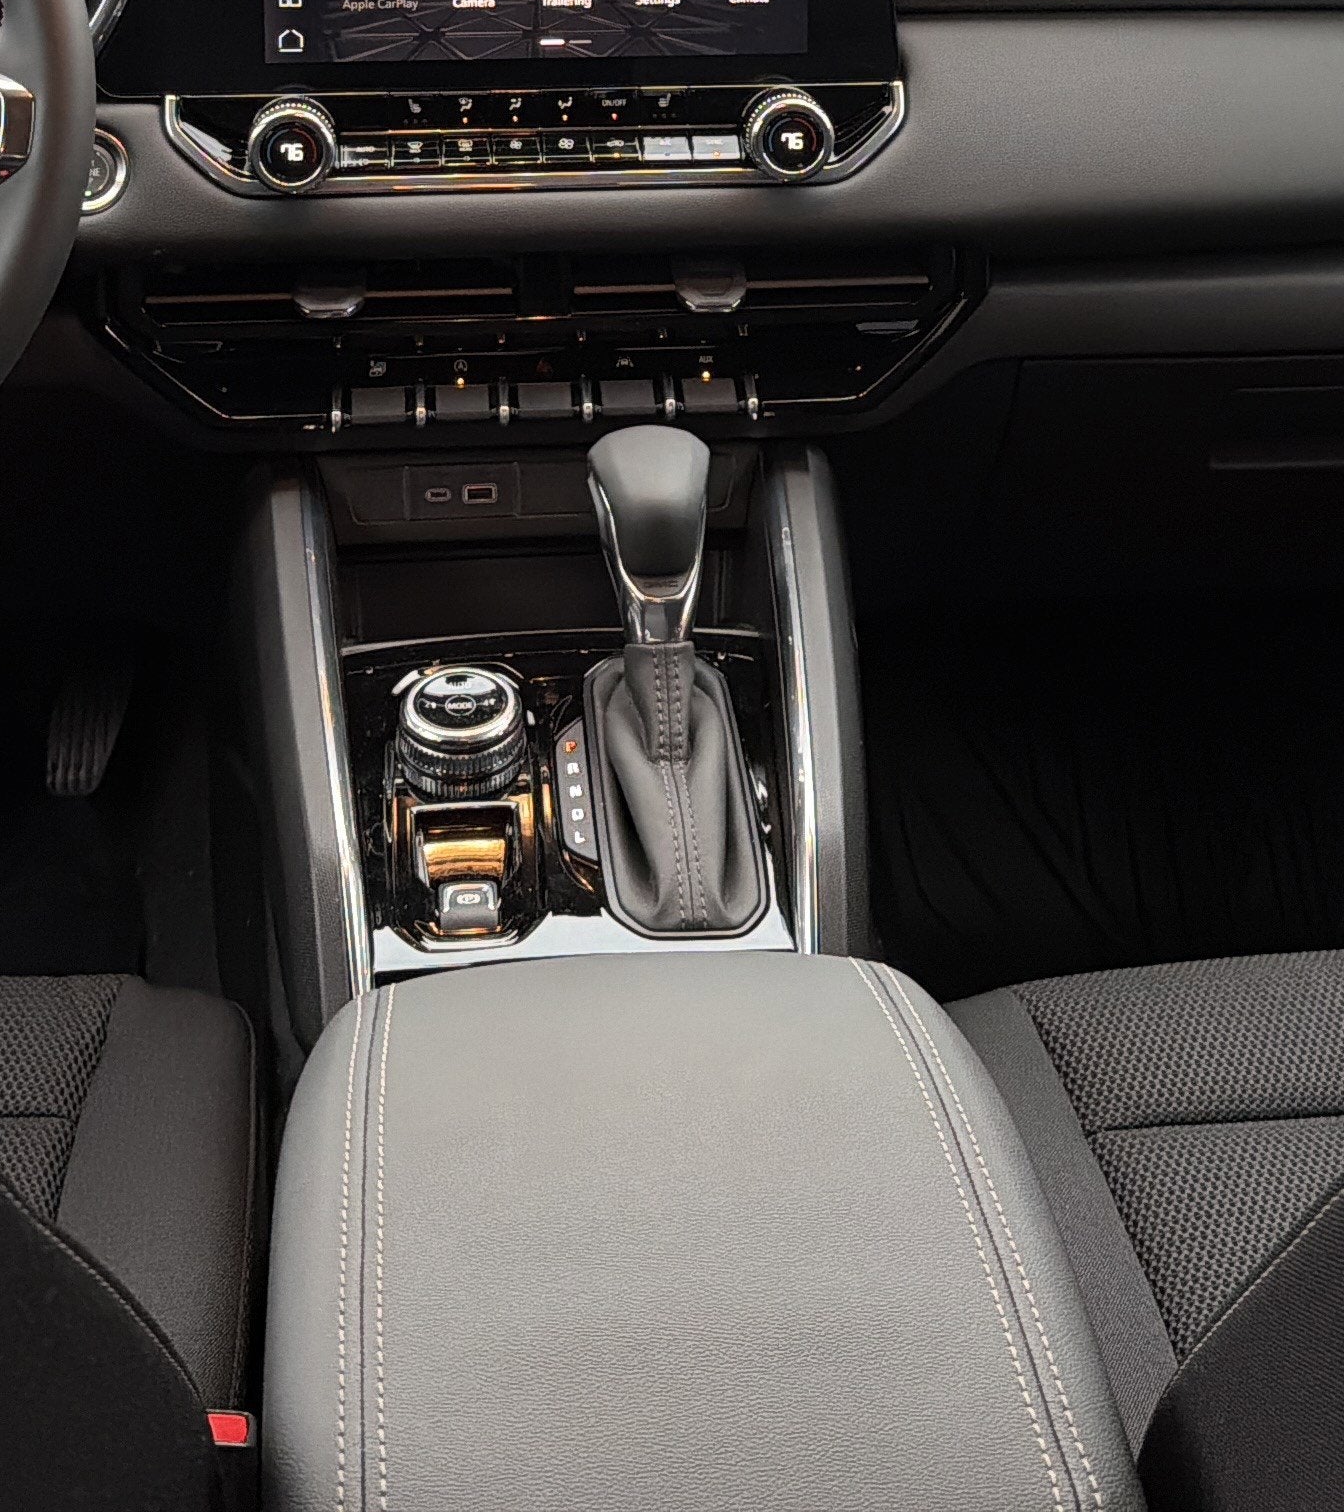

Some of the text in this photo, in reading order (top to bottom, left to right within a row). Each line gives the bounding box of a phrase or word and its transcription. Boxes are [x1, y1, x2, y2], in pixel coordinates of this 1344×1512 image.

[601, 99, 627, 107] ON/OFF
[699, 355, 714, 363] AUX
[447, 702, 472, 710] MODE
[565, 740, 577, 754] P
[567, 763, 580, 774] R
[569, 784, 582, 798] N
[571, 808, 584, 821] D
[574, 831, 586, 844] L
